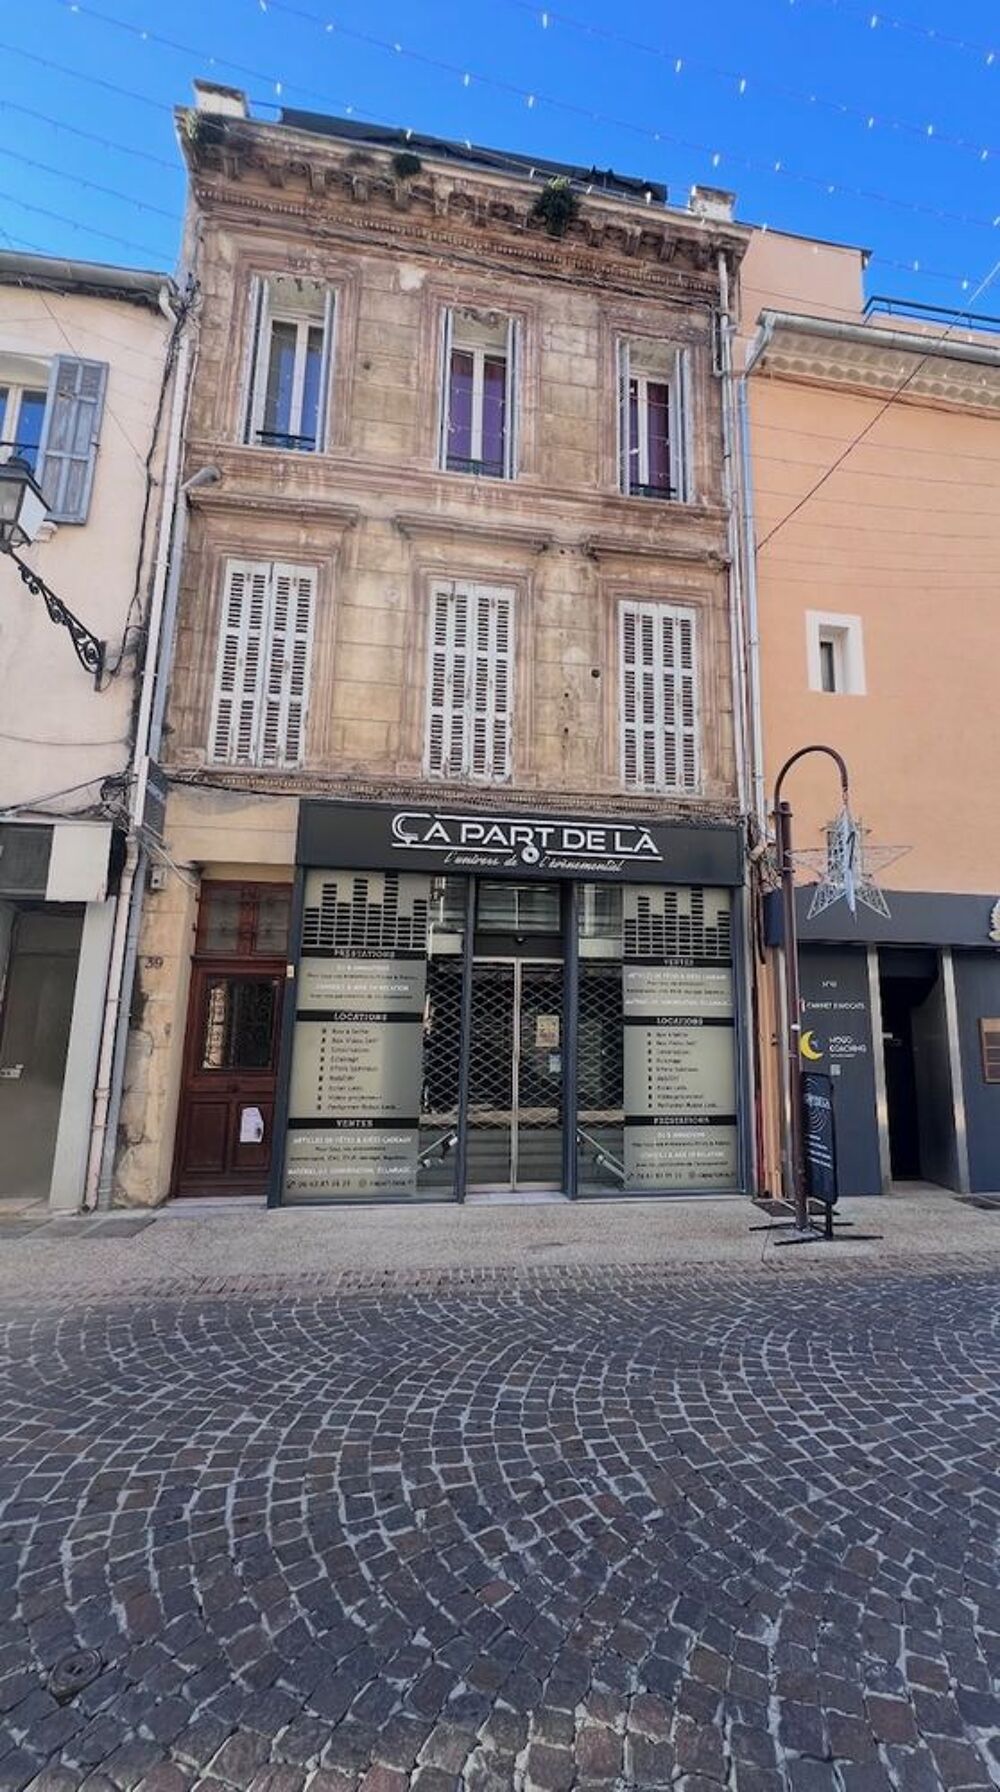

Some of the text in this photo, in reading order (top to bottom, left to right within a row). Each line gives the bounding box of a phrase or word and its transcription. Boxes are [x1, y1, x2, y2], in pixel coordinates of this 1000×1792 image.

[460, 823, 555, 848] PART
[561, 829, 606, 850] DE
[614, 826, 660, 853] LÀ
[503, 854, 517, 866] de
[144, 956, 164, 969] 39
[334, 1012, 388, 1022] LOCATIONS
[336, 1119, 374, 1128] VENTES
